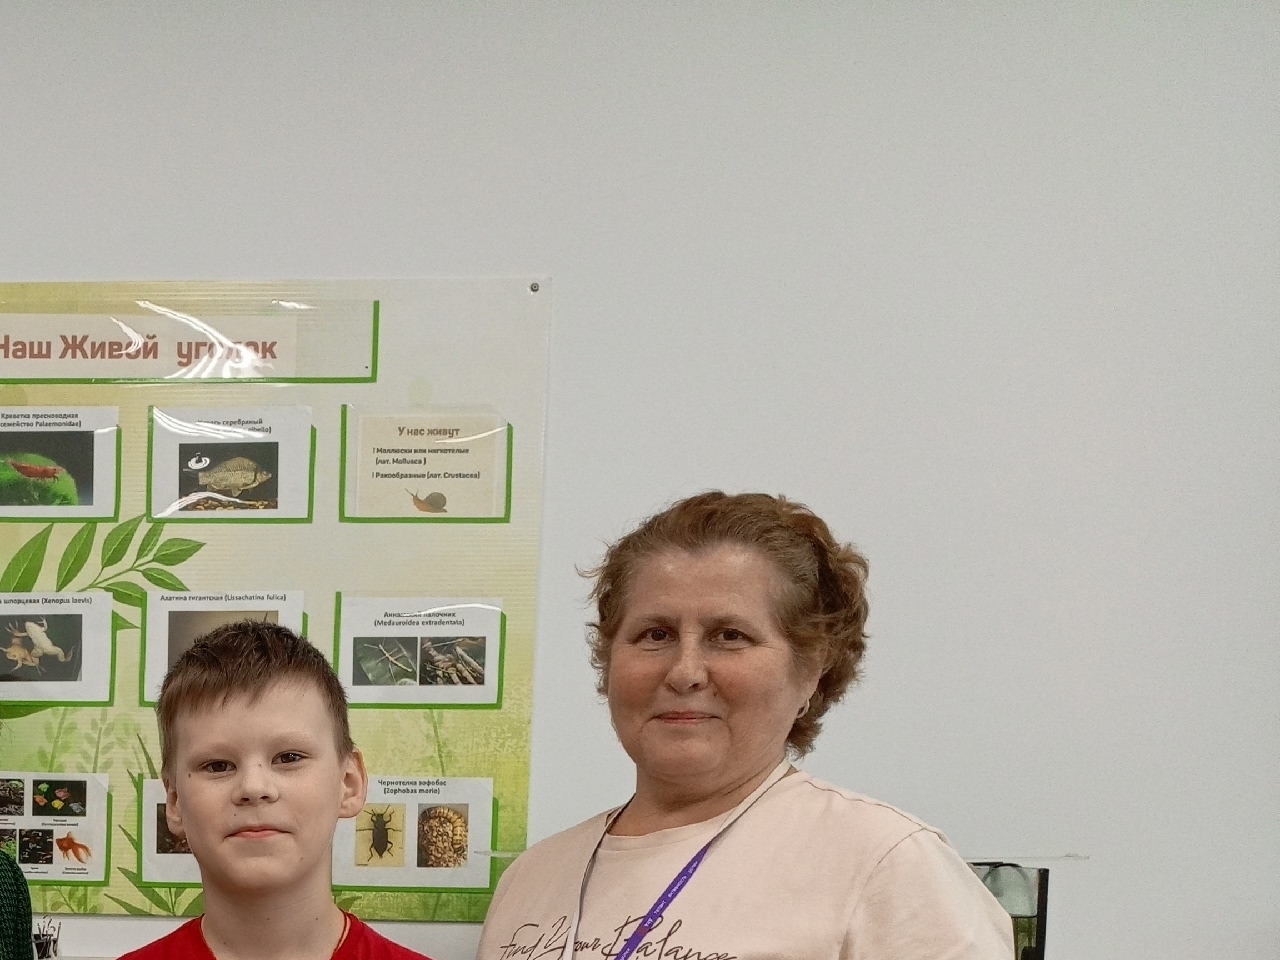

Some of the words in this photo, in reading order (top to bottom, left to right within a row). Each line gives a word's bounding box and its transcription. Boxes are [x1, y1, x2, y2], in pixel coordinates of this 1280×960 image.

[59, 333, 159, 360] Живой
[0, 413, 31, 421] Креветка
[32, 413, 79, 421] пресноводная
[222, 418, 263, 426] серебряный
[398, 426, 406, 436] У
[407, 428, 425, 436] нас
[427, 428, 460, 438] живут
[375, 471, 426, 479] Ракообразные
[443, 471, 481, 479] Crustacea)
[3, 598, 40, 606] шпорцевая
[41, 597, 70, 605] (Xenopus
[224, 594, 265, 602] (Lissachatina
[266, 593, 287, 602] fulica)
[418, 779, 447, 787] зофобас
[383, 787, 417, 795] (Zophobas
